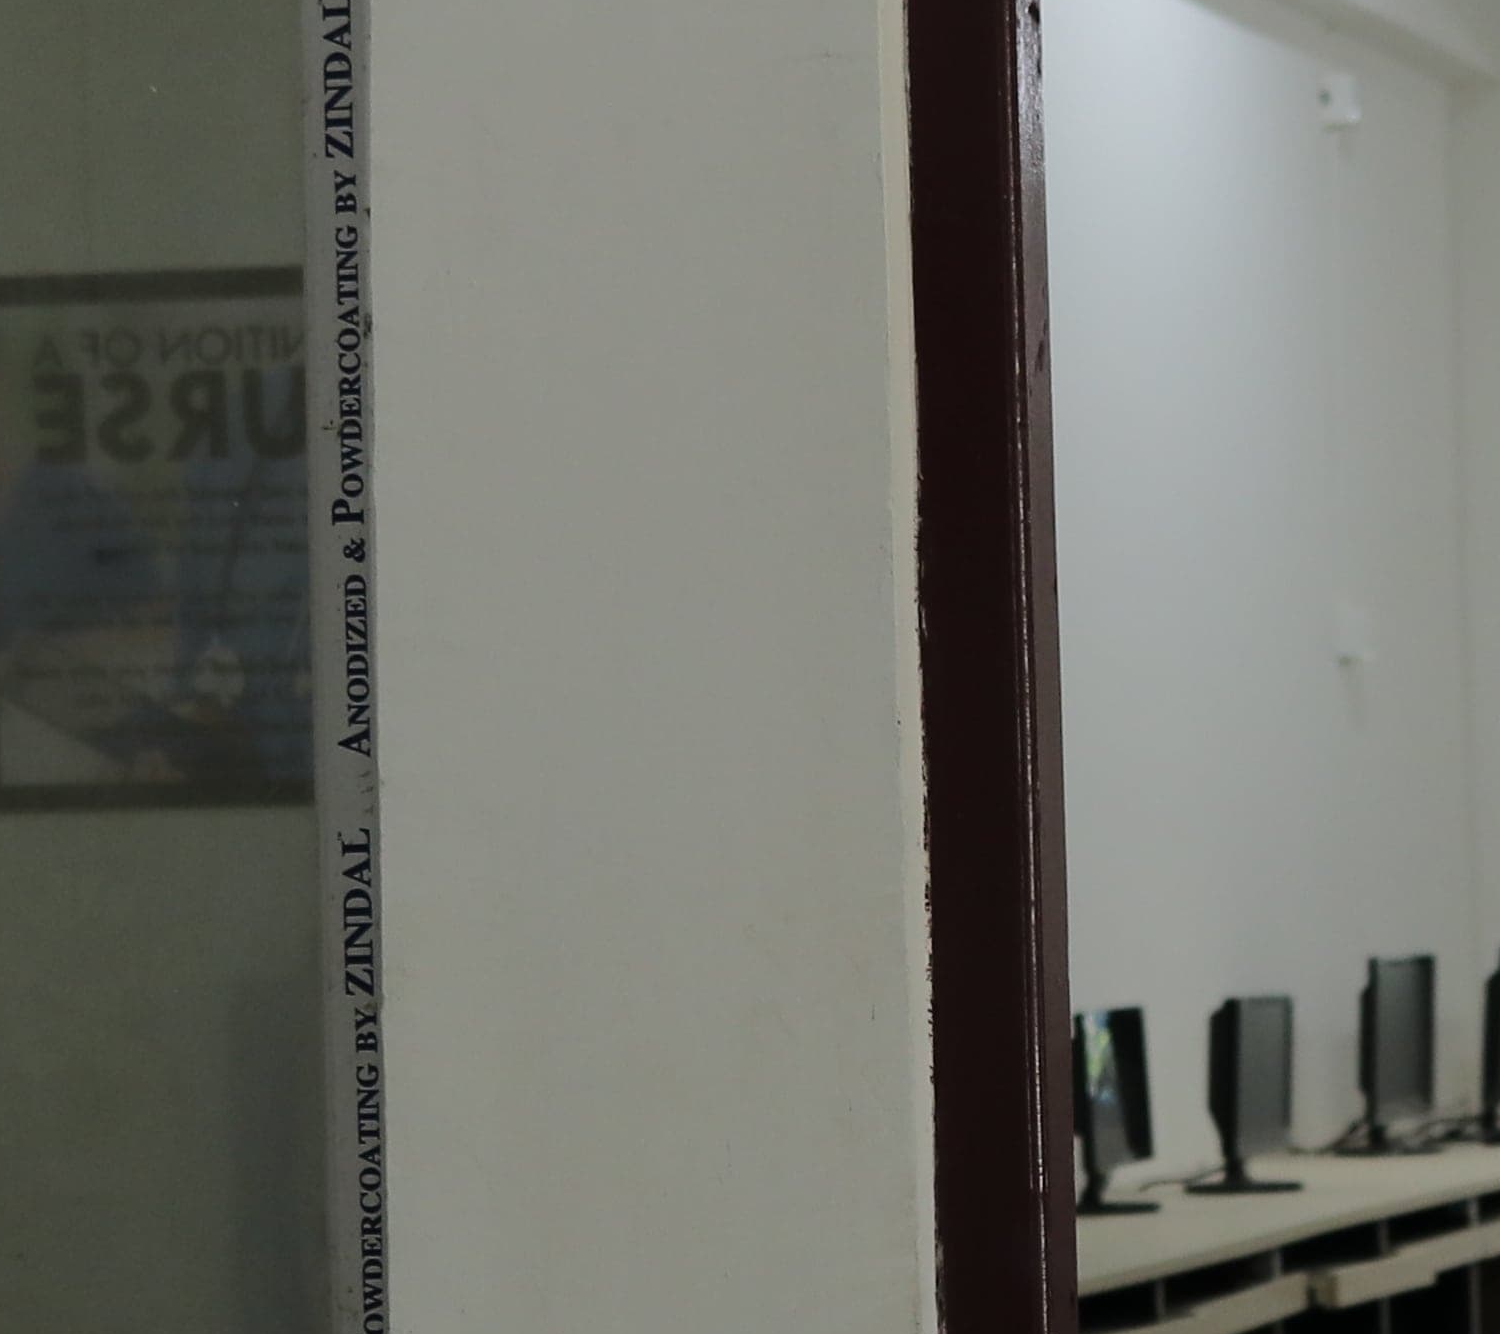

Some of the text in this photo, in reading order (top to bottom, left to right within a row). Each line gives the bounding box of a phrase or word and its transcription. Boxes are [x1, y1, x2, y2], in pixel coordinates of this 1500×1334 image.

[333, 169, 357, 215] BY
[331, 224, 365, 526] POWDERCOATING
[343, 537, 366, 564] &
[337, 573, 371, 758] ANODIZED
[342, 827, 375, 997] ZINDAL
[354, 1009, 379, 1054] BY
